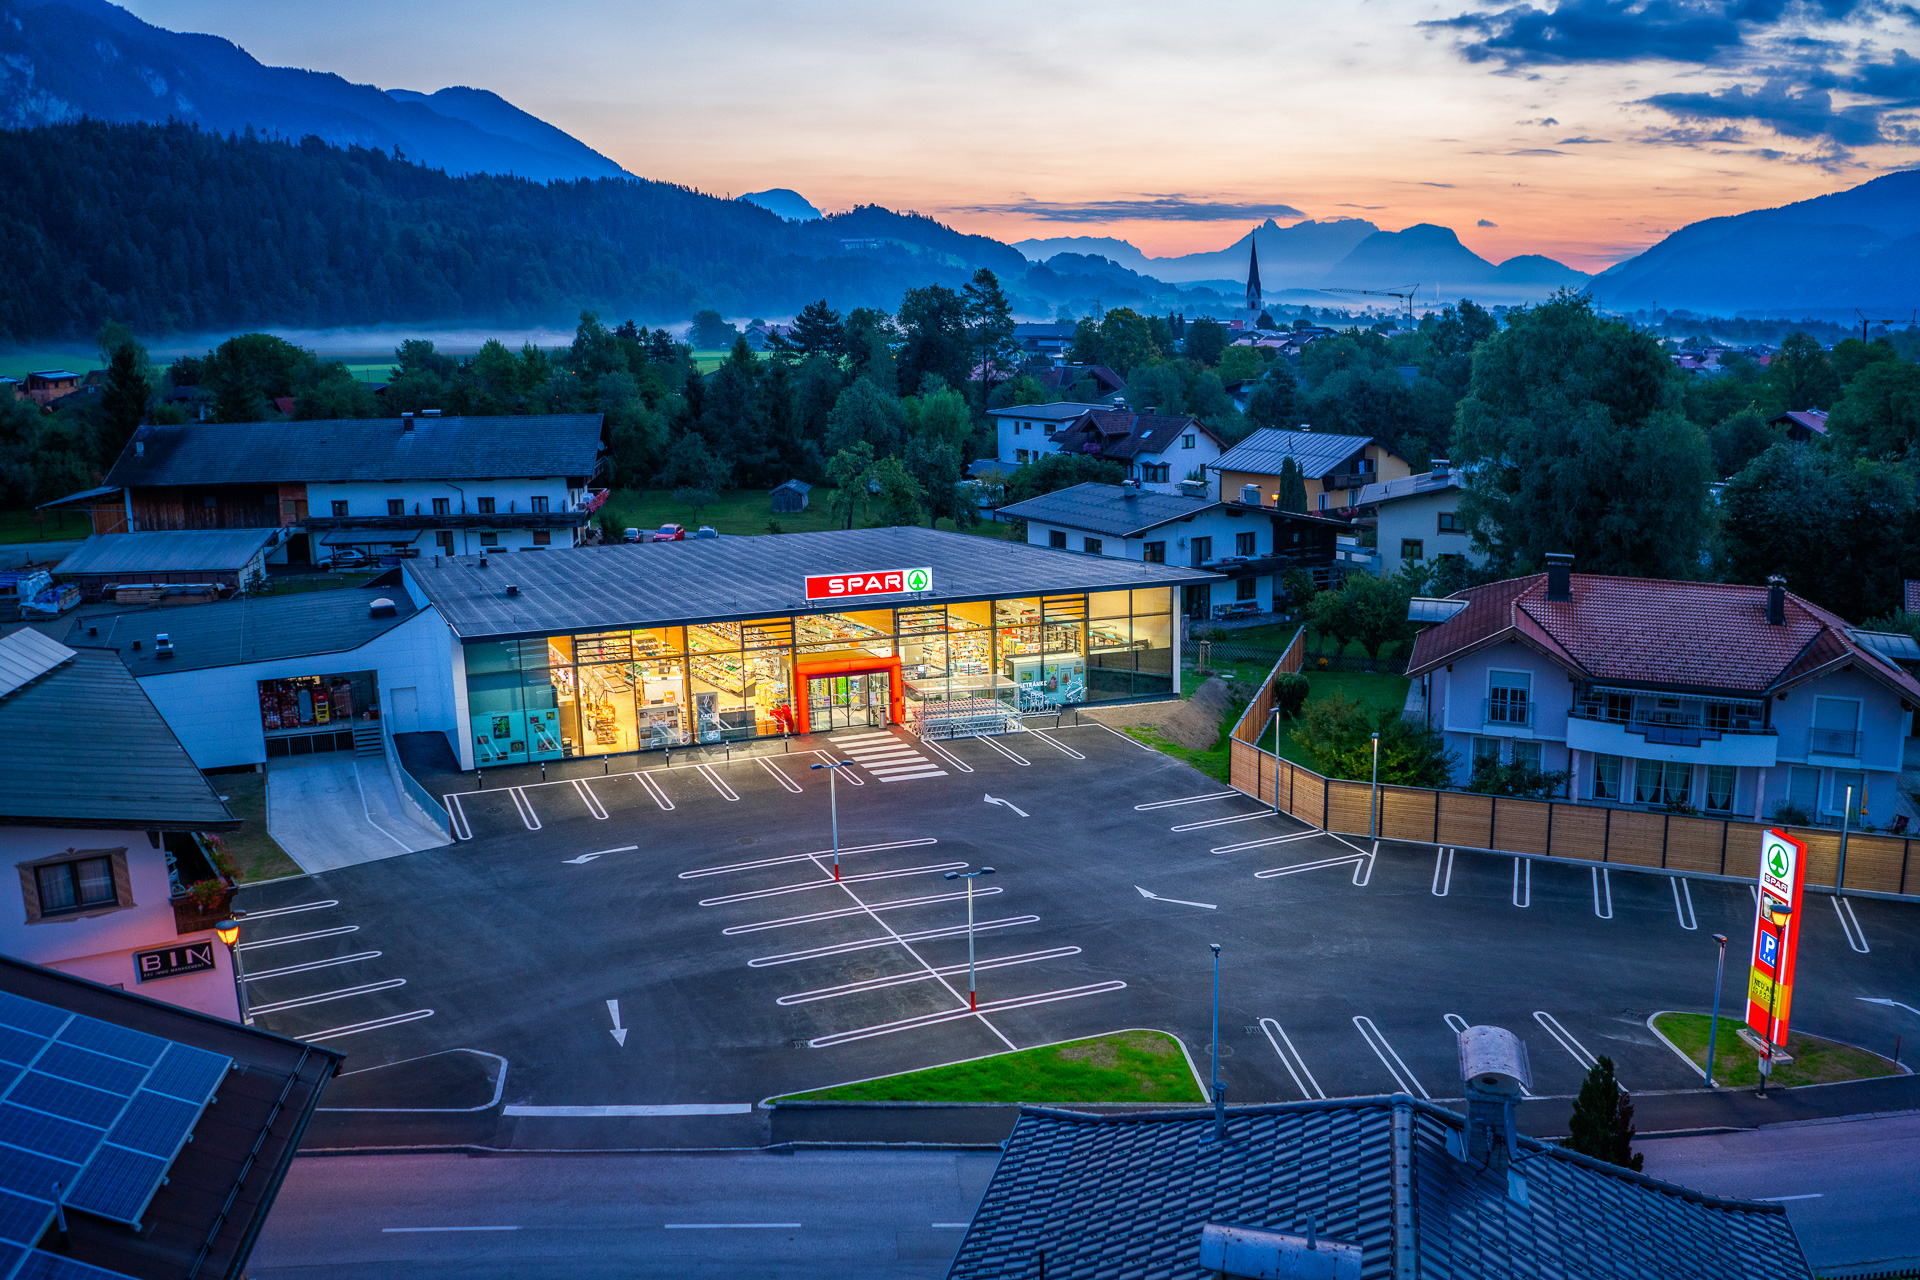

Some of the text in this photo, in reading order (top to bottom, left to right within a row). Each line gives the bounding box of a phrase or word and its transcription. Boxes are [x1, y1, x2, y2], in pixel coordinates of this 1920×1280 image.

[828, 574, 901, 594] SPAR
[1764, 874, 1788, 893] SPAR
[1766, 936, 1775, 953] P
[141, 946, 211, 972] BIM
[170, 963, 204, 972] MANAGEMENT
[1754, 978, 1765, 989] NEU
